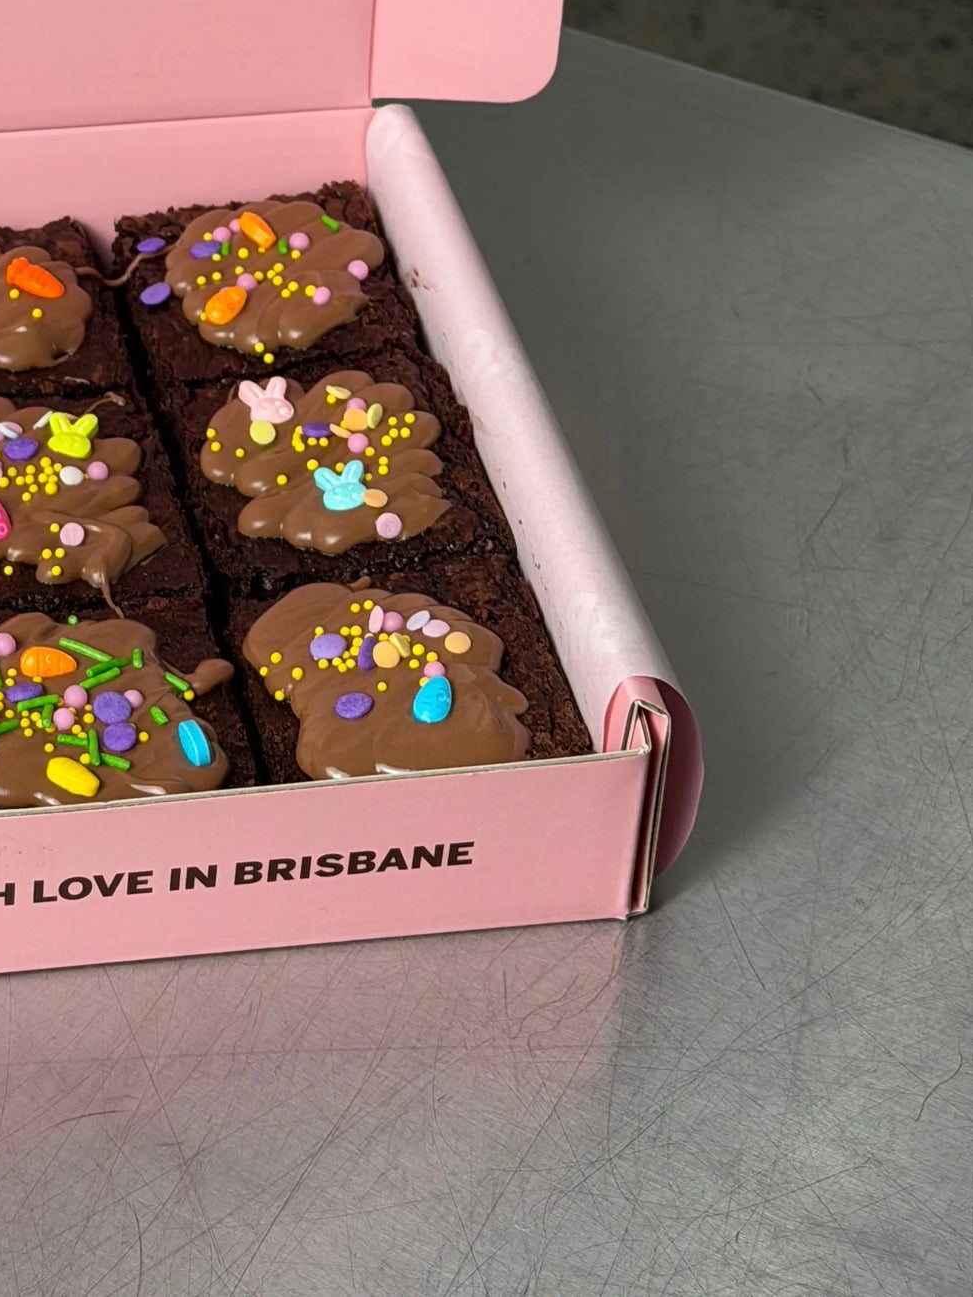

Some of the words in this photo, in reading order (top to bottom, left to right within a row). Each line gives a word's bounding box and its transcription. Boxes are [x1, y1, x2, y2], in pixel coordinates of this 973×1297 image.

[32, 870, 154, 904] LOVE
[169, 864, 218, 892] IN
[233, 841, 475, 886] BRISBANE
